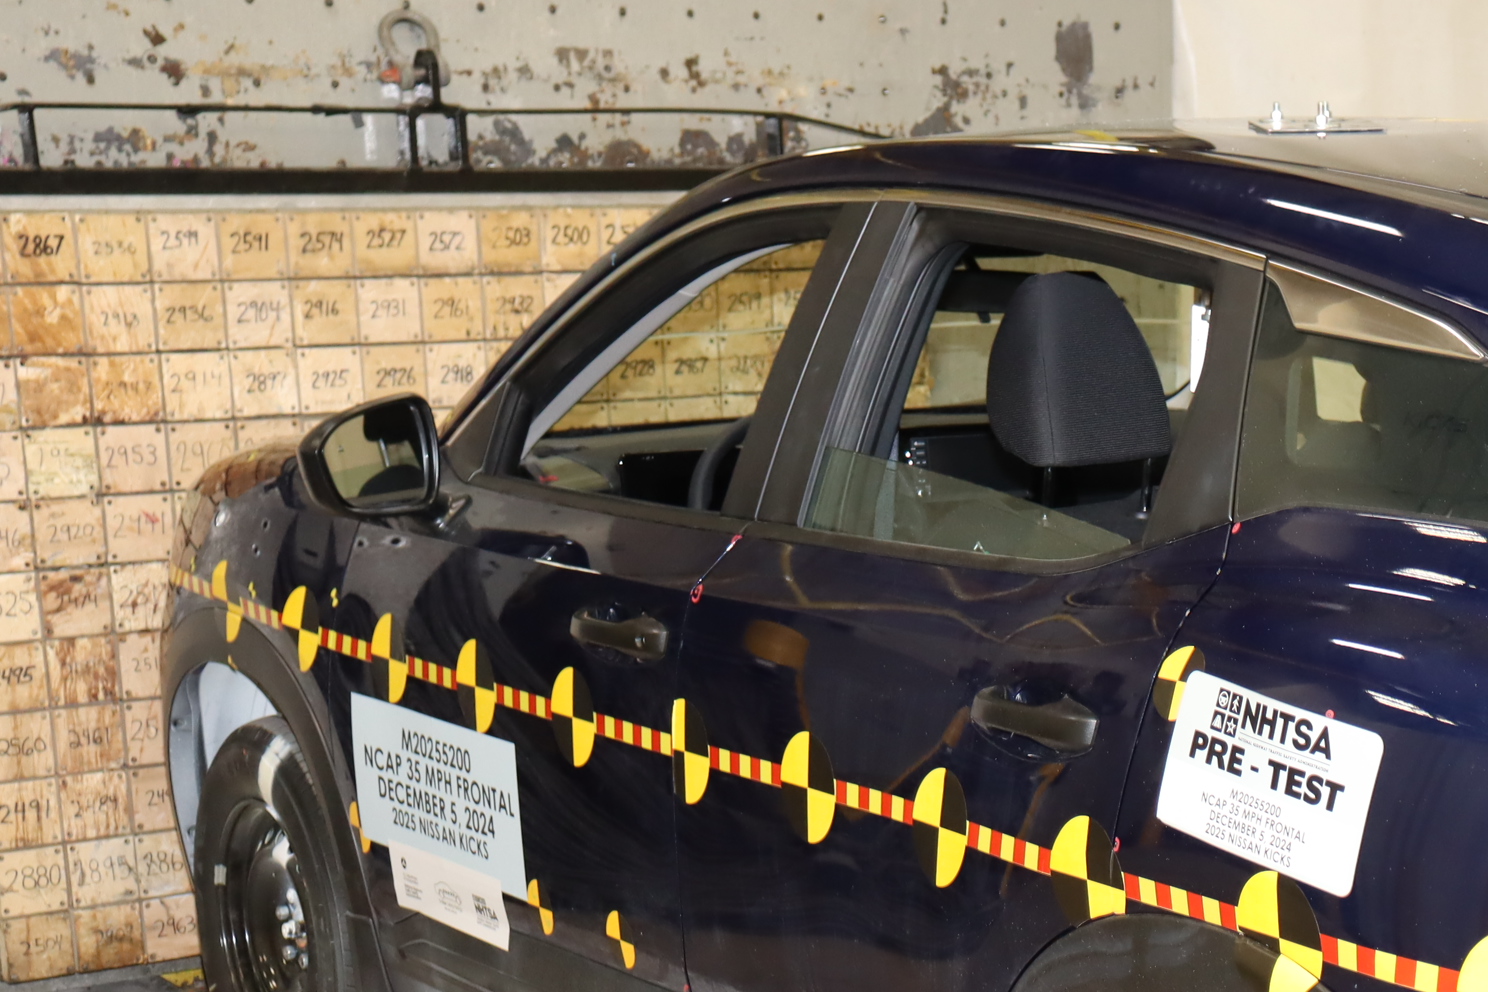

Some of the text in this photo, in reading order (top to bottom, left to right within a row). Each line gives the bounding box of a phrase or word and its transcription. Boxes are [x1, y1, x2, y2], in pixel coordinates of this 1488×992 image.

[18, 234, 65, 258] 2867
[230, 231, 269, 254] 2591
[300, 230, 344, 254] 2574
[366, 228, 407, 249] 2527
[551, 225, 591, 246] 2500
[165, 304, 214, 324] 2936
[237, 300, 281, 324] 2904
[305, 299, 340, 319] 2916
[371, 299, 407, 319] 2931
[170, 370, 222, 393] 2914
[312, 369, 350, 389] 2925
[376, 366, 416, 388] 2926
[440, 365, 474, 384] 2918
[105, 444, 158, 468] 2953
[47, 523, 95, 544] 2920
[69, 728, 111, 749] 2461
[1241, 698, 1332, 761] NHTSA
[401, 727, 471, 774] M20255200
[364, 744, 515, 818] NCAP 35 MPH FRONTAL
[1189, 729, 1246, 777] PRE
[1268, 758, 1346, 812] TEST
[0, 799, 50, 824] 2491
[377, 776, 496, 839] DECEMBER 5, 2024
[1229, 788, 1282, 818] M20255200
[1201, 791, 1306, 845] NCAP 35 MPH FRONTAL
[392, 807, 489, 860] 2025 NISSAN KICKS
[1209, 809, 1257, 839] DECEMBER
[1269, 834, 1292, 853] 2024
[1205, 822, 1291, 868] 2025 NISSAN KICKS
[5, 864, 62, 893] 2880
[474, 903, 499, 922] NHTSA
[155, 916, 197, 938] 2963
